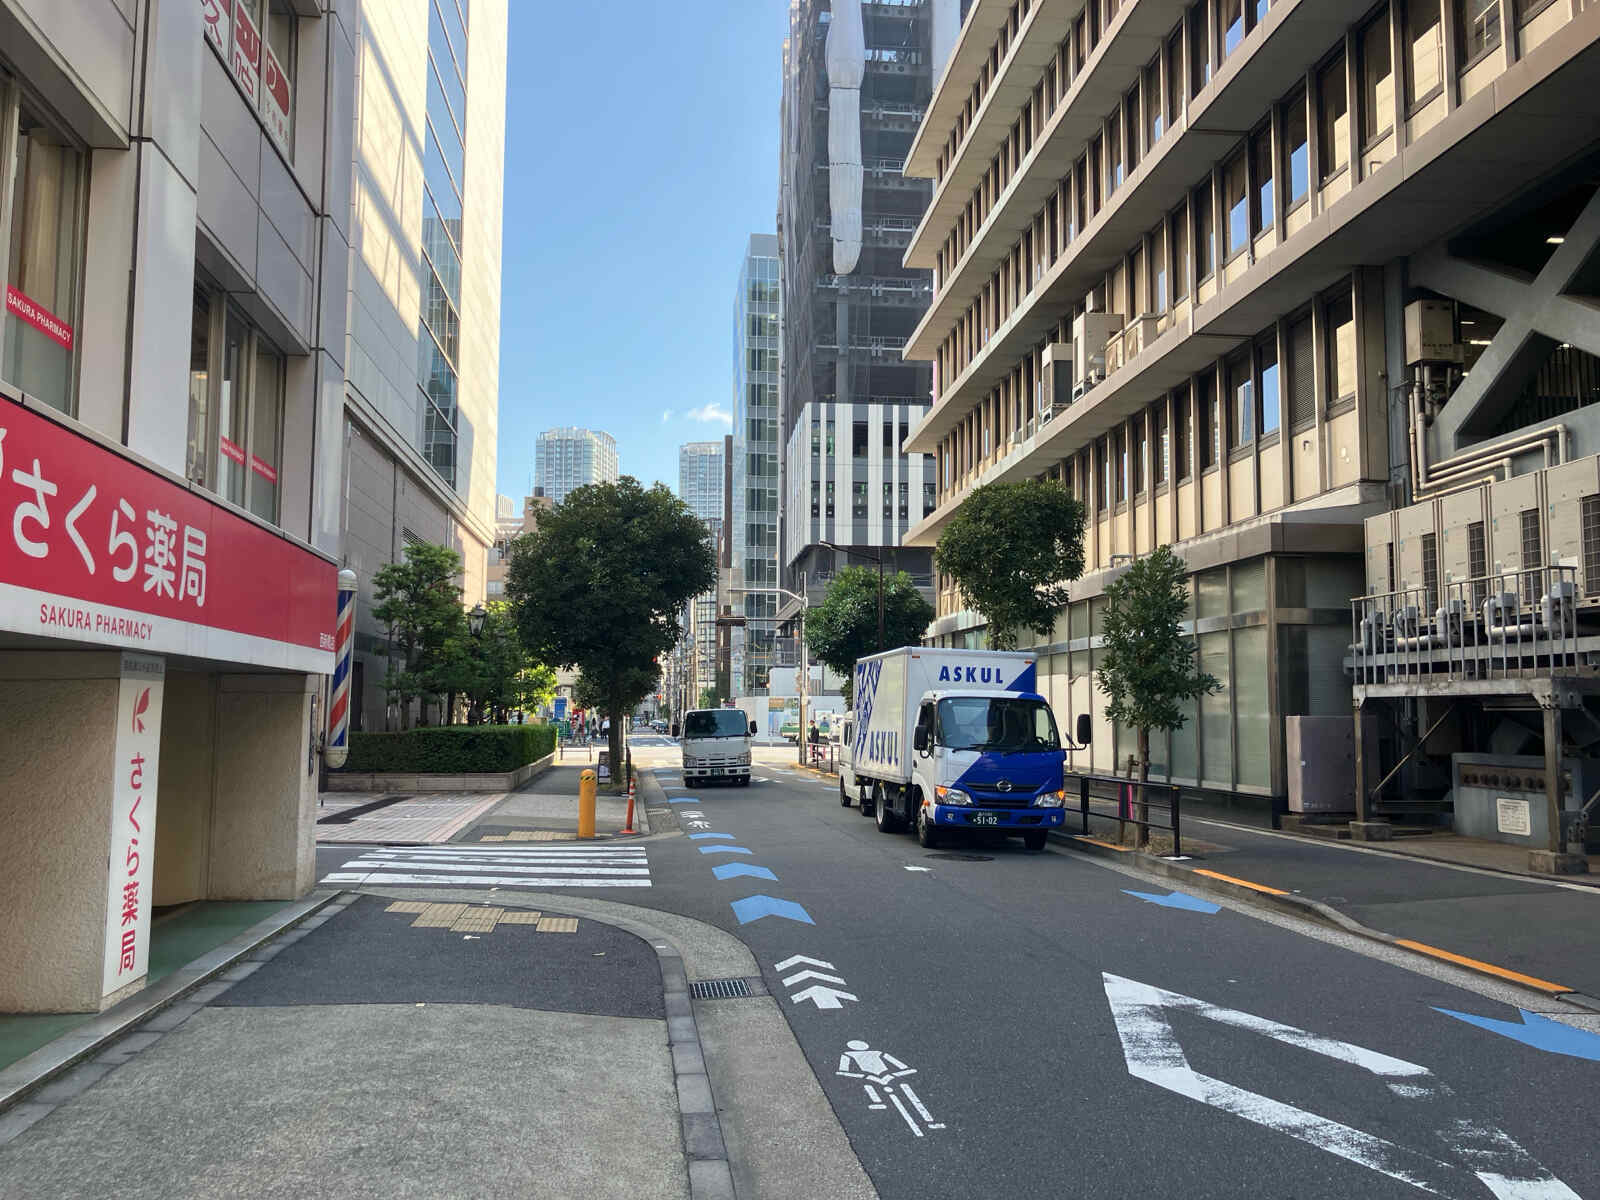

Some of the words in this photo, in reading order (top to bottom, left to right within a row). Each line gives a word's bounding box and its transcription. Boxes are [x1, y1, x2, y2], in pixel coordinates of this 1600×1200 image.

[8, 292, 36, 321] SAKURA
[36, 311, 71, 343] PHARMACY
[12, 458, 208, 608] さくら薬局
[40, 603, 92, 632] SAKURA
[95, 613, 153, 642] PHARMACY
[938, 665, 1004, 685] ASKUL
[868, 730, 899, 767] ASKUL
[118, 751, 147, 977] さくら薬局
